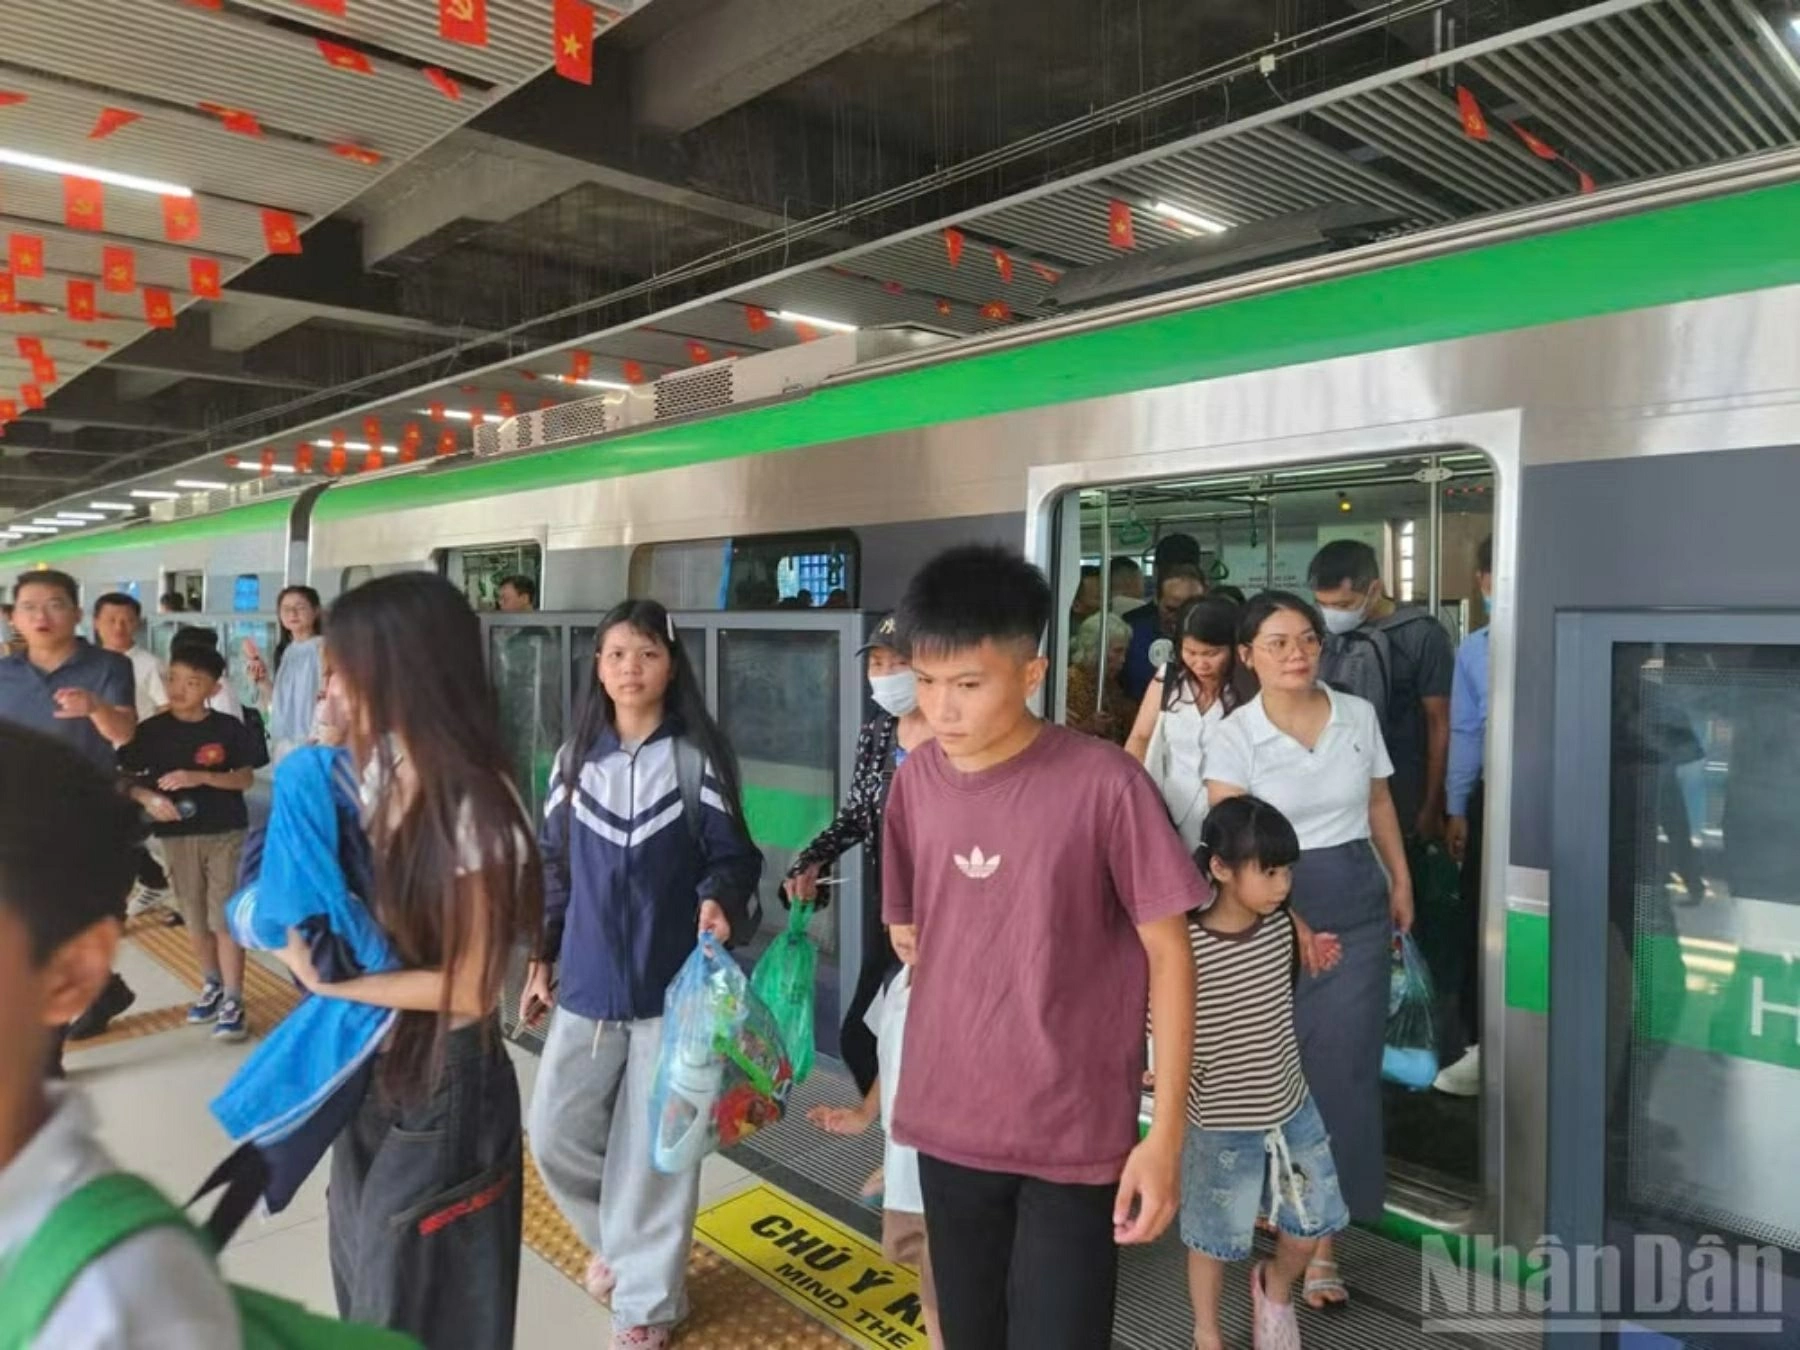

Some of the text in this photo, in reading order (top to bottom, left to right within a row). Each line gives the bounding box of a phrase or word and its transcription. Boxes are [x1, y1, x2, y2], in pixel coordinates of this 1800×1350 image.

[750, 1214, 928, 1337] CHÚ Ý K
[774, 1262, 914, 1349] MIND THE
